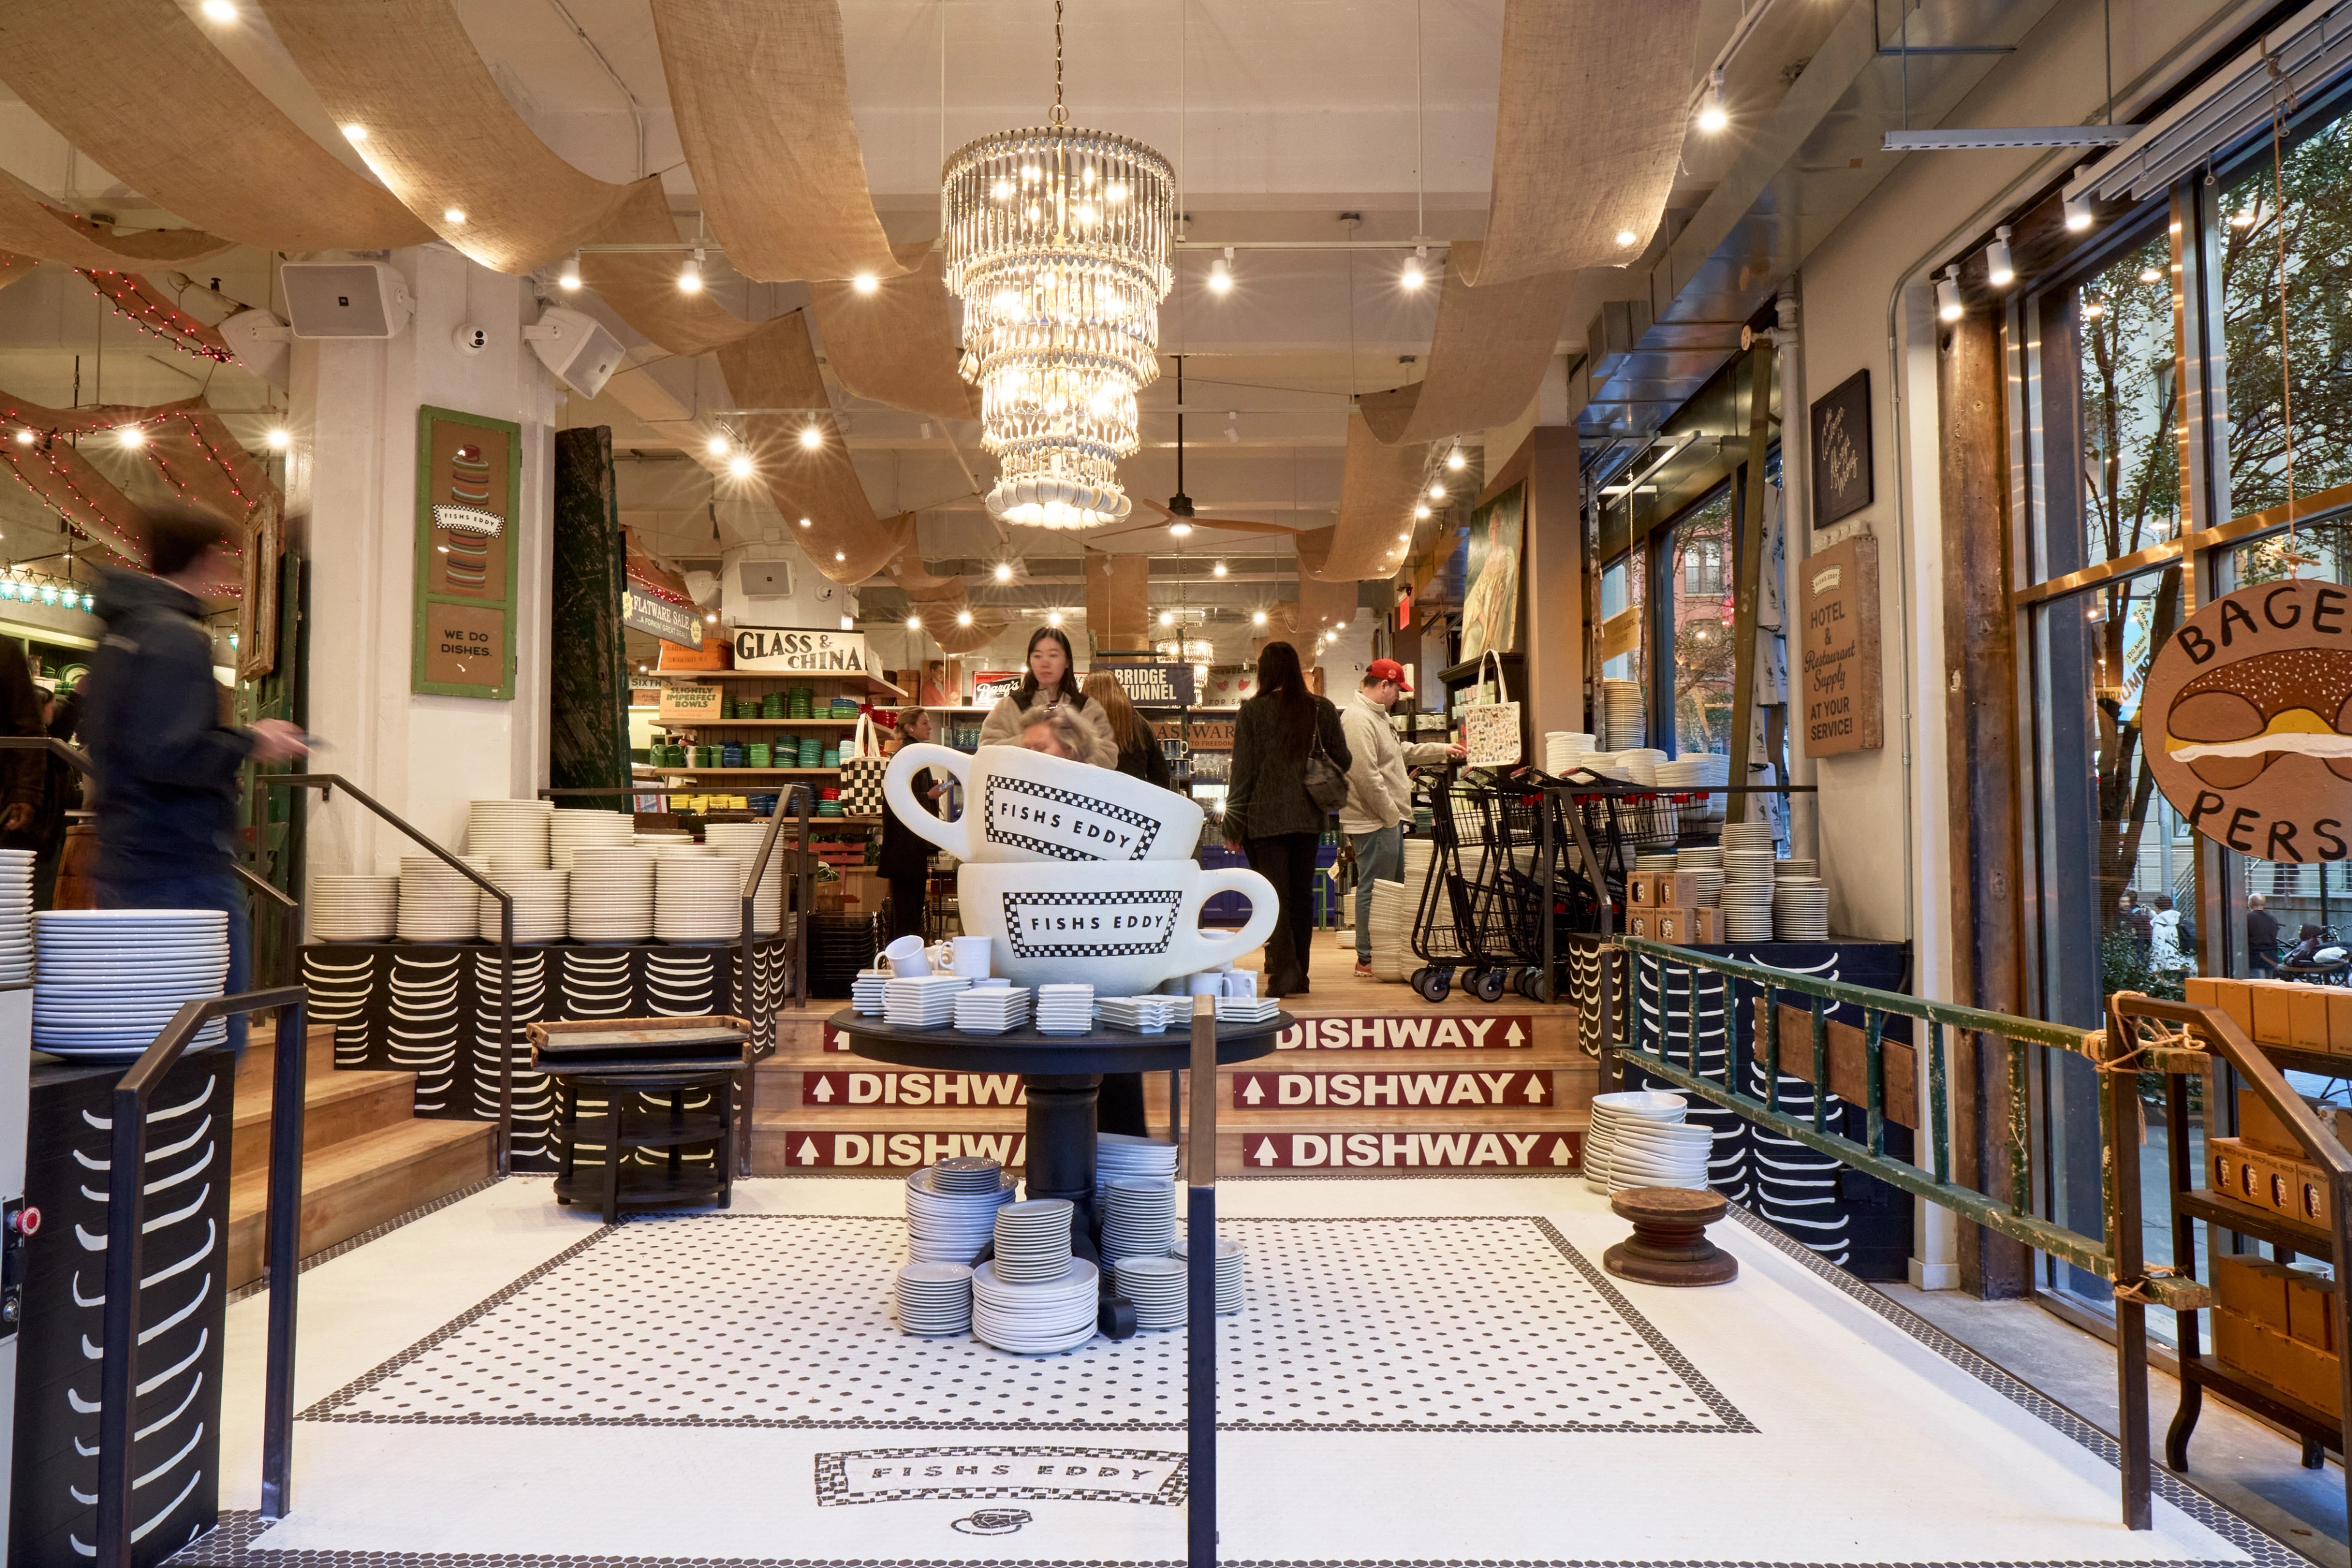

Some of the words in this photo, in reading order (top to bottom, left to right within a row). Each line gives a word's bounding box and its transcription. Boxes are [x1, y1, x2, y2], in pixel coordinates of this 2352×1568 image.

[444, 513, 471, 522] FISHS
[474, 514, 495, 527] EDDY
[633, 595, 671, 623] FLATWARE
[673, 611, 690, 630] SALE
[1811, 600, 1845, 630] HOTEL
[444, 629, 464, 641] WE
[469, 631, 489, 643] DO
[662, 625, 676, 635] GREAT
[1825, 627, 1832, 645] &
[2177, 586, 2352, 665] BAGE
[441, 644, 492, 657] DISHES.
[736, 631, 812, 660] GLASS
[819, 635, 834, 649] &
[1804, 640, 1856, 673] Restaurant
[2127, 649, 2136, 660] 170
[2134, 635, 2146, 652] Artist
[2132, 646, 2147, 664] Studios
[787, 646, 862, 671] CHINA
[631, 678, 662, 687] SIXTH
[1114, 668, 1167, 685] BRIDGE
[1813, 663, 1846, 695] Supply
[976, 680, 1020, 701] Barq's
[1121, 684, 1177, 700] TUNNEL
[1811, 703, 1821, 720] AT
[1824, 696, 1850, 716] YOUR
[1811, 717, 1852, 742] SERVICE!
[1001, 802, 1061, 828] FISHS
[1072, 821, 1131, 848] EDDY
[2189, 790, 2348, 862] PERS
[1031, 918, 1100, 930] FISHS
[1114, 916, 1164, 929] EDDY
[1276, 1018, 1496, 1049] DISHWAY
[848, 1073, 1027, 1106] DISHW
[1278, 1072, 1515, 1105] DISHWAY
[834, 1134, 1027, 1166] DISHW
[1292, 1133, 1540, 1166] DISHWAY
[871, 1464, 1011, 1479] FISHS
[1037, 1464, 1154, 1480] EDDY
